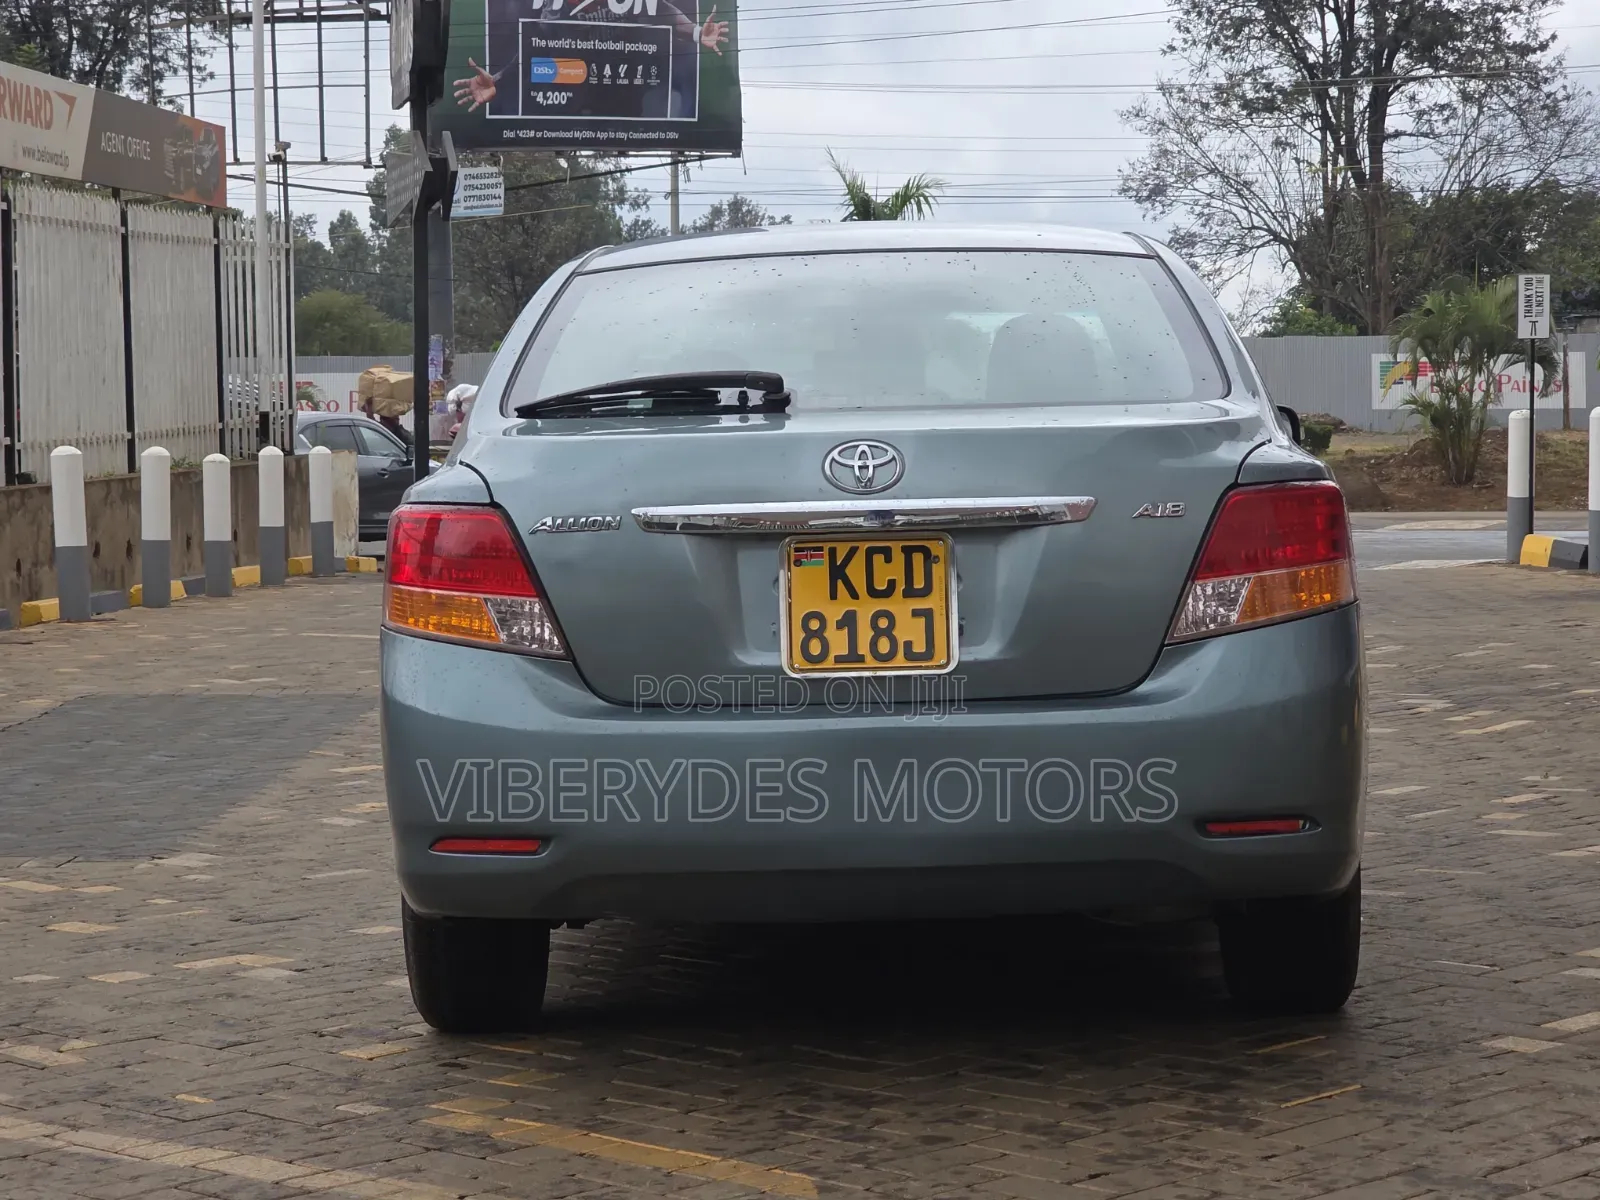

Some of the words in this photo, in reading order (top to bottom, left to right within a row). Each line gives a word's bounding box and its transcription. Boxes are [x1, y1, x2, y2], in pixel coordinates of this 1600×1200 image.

[531, 37, 546, 47] The
[548, 38, 576, 49] world's
[577, 39, 594, 49] best
[595, 39, 624, 50] football
[625, 41, 658, 54] package
[536, 91, 567, 106] 4,200
[503, 130, 516, 138] Dial
[543, 130, 573, 138] Download
[574, 130, 596, 140] MyDStv
[596, 131, 608, 140] App
[616, 132, 627, 141] stay
[629, 131, 659, 139] Connected
[101, 132, 125, 155] AGENT
[127, 137, 151, 161] OFFICE
[1523, 277, 1533, 292] YOU
[1523, 294, 1533, 319] THANK
[1535, 290, 1544, 307] NEXT
[1131, 502, 1185, 518] A18
[528, 515, 622, 534] ALLION
[828, 544, 934, 601] KCD
[800, 607, 936, 664] 818J
